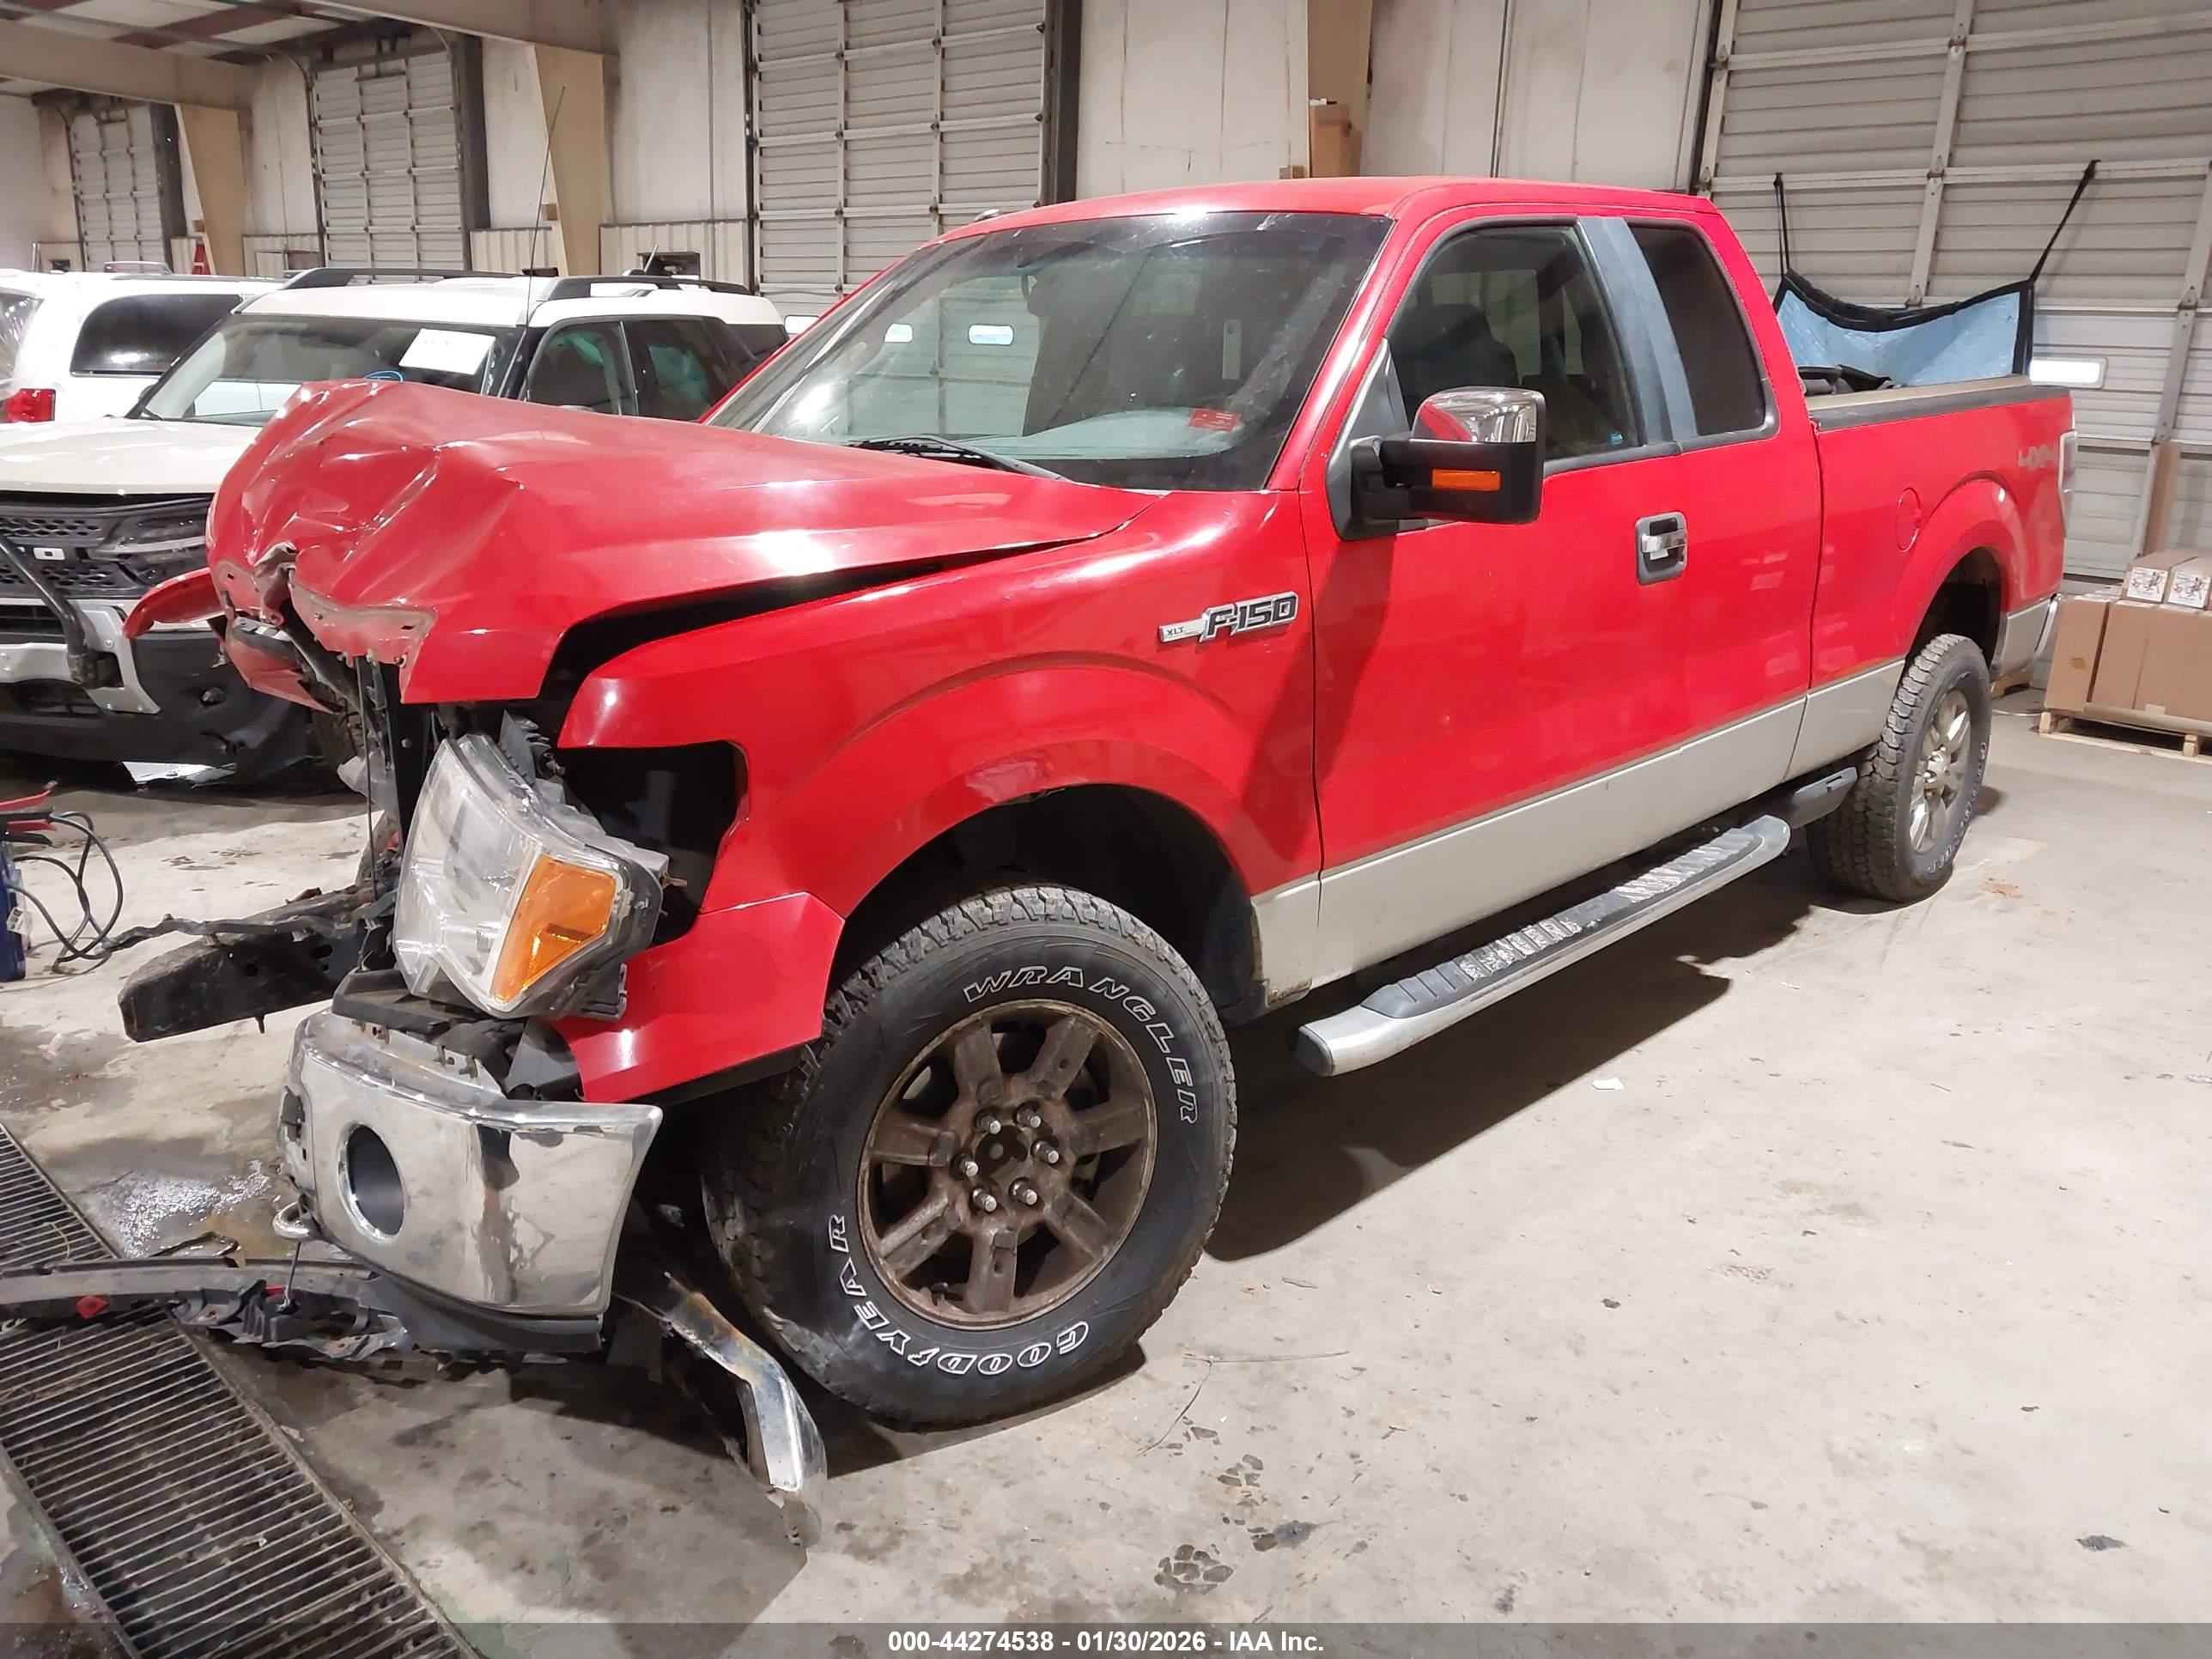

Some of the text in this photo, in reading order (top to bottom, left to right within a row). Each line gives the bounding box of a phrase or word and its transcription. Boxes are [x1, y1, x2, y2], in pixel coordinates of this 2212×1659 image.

[1166, 592, 1298, 640] XLT F-150
[963, 965, 1199, 1124] WRANGLER
[829, 1214, 1090, 1375] GOODYEAR
